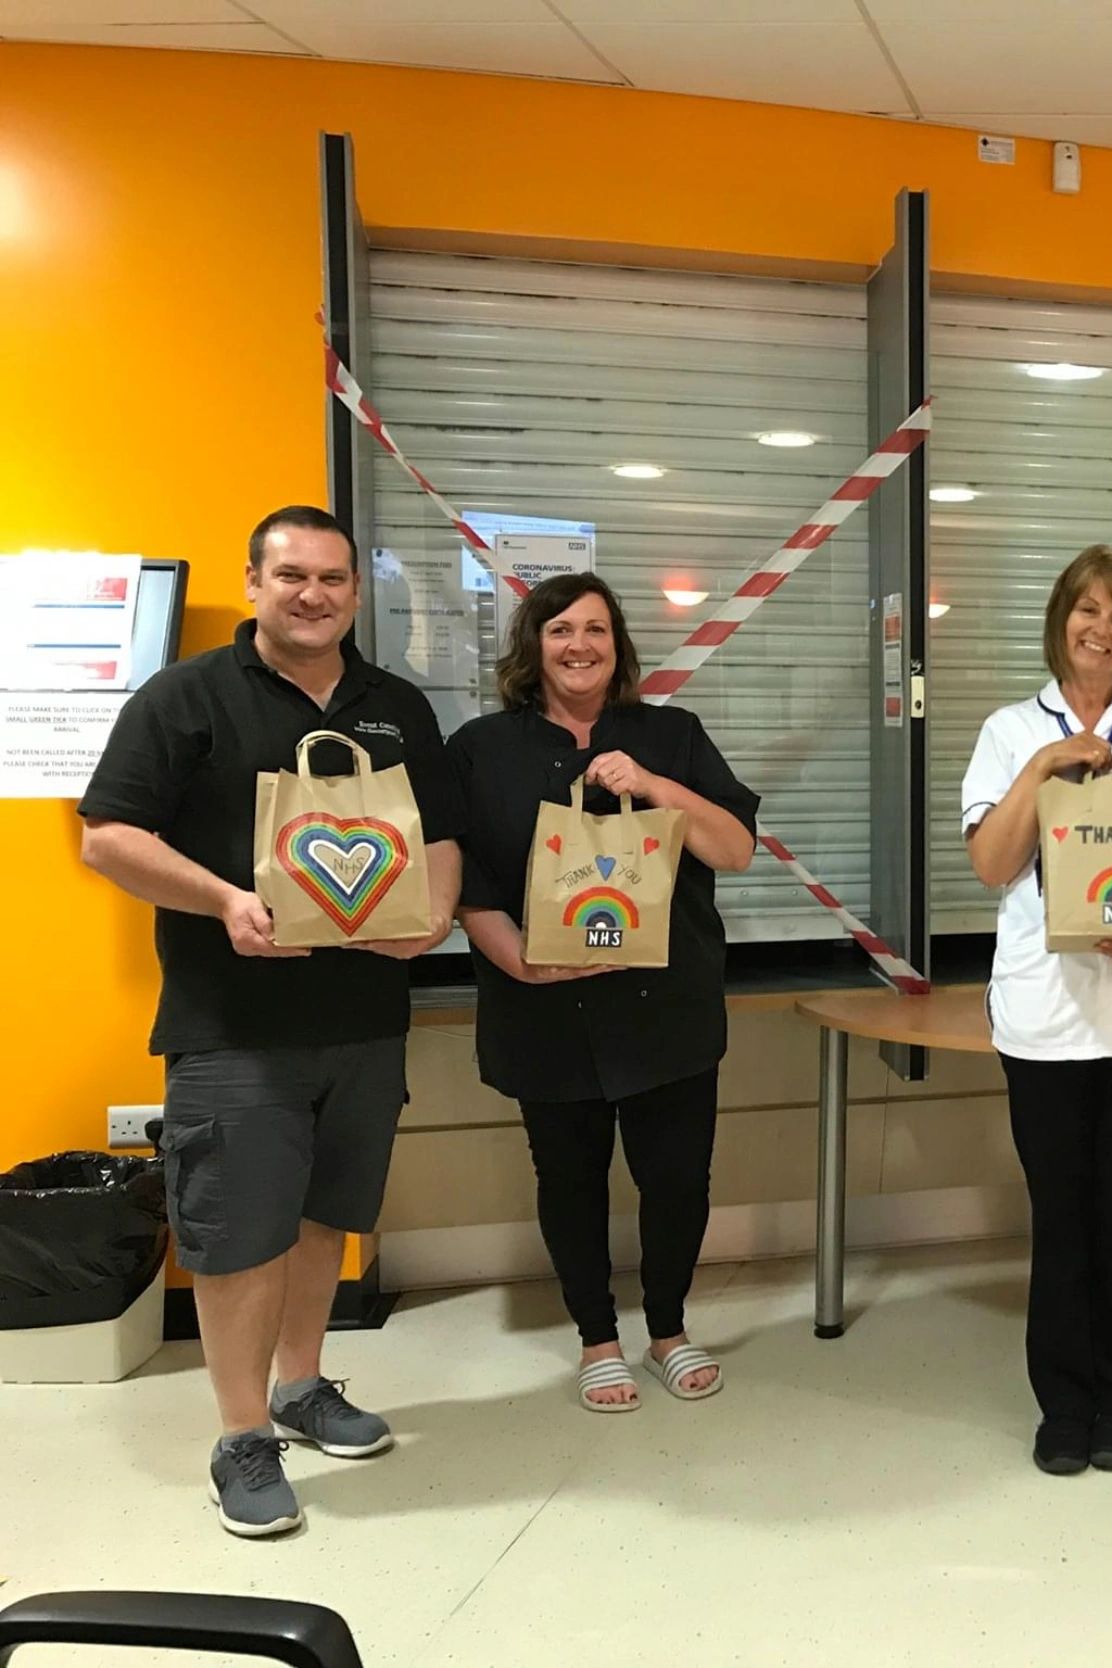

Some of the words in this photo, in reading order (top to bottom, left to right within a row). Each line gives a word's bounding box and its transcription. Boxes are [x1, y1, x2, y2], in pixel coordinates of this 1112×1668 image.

[333, 857, 364, 874] NHS
[555, 864, 594, 888] THANK
[617, 863, 642, 885] YOU
[588, 930, 622, 946] NHS
